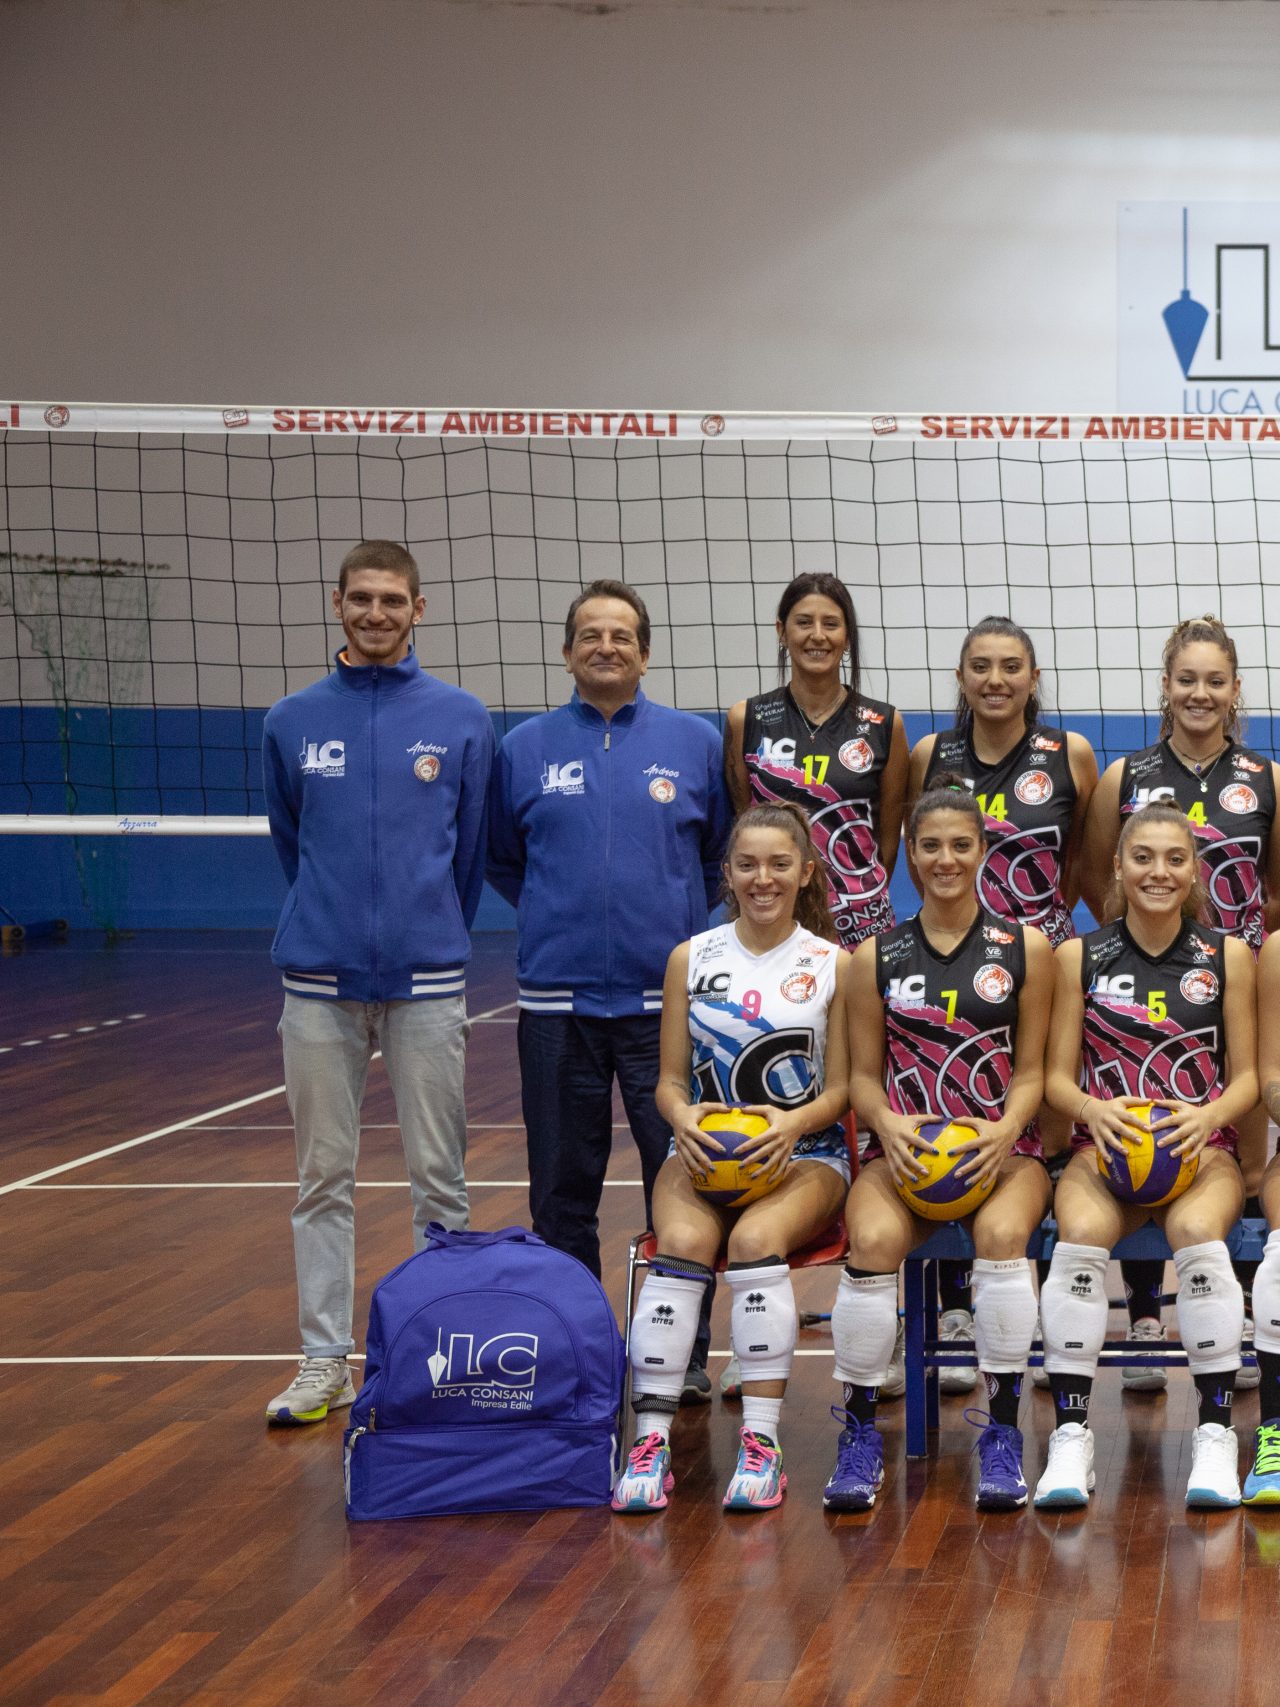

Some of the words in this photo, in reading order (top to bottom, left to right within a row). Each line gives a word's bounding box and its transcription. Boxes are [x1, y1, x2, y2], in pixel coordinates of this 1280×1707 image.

[1183, 388, 1262, 415] LUCA
[271, 409, 426, 434] SERVIZI
[440, 410, 679, 437] AMBIENTALI
[920, 415, 1069, 440] SERVIZI
[406, 740, 448, 755] Andrea
[642, 763, 680, 778] Andrea
[802, 755, 831, 785] 17
[976, 793, 1009, 823] 14
[1186, 801, 1209, 828] 4
[741, 989, 762, 1021] 9
[940, 989, 958, 1025] 7
[1147, 991, 1168, 1023] 5
[651, 1316, 674, 1326] errea
[437, 1332, 539, 1388] LC
[431, 1389, 467, 1400] LUCA
[471, 1388, 534, 1402] CONSANI
[471, 1399, 508, 1410] Impresa
[510, 1401, 533, 1411] Edile
